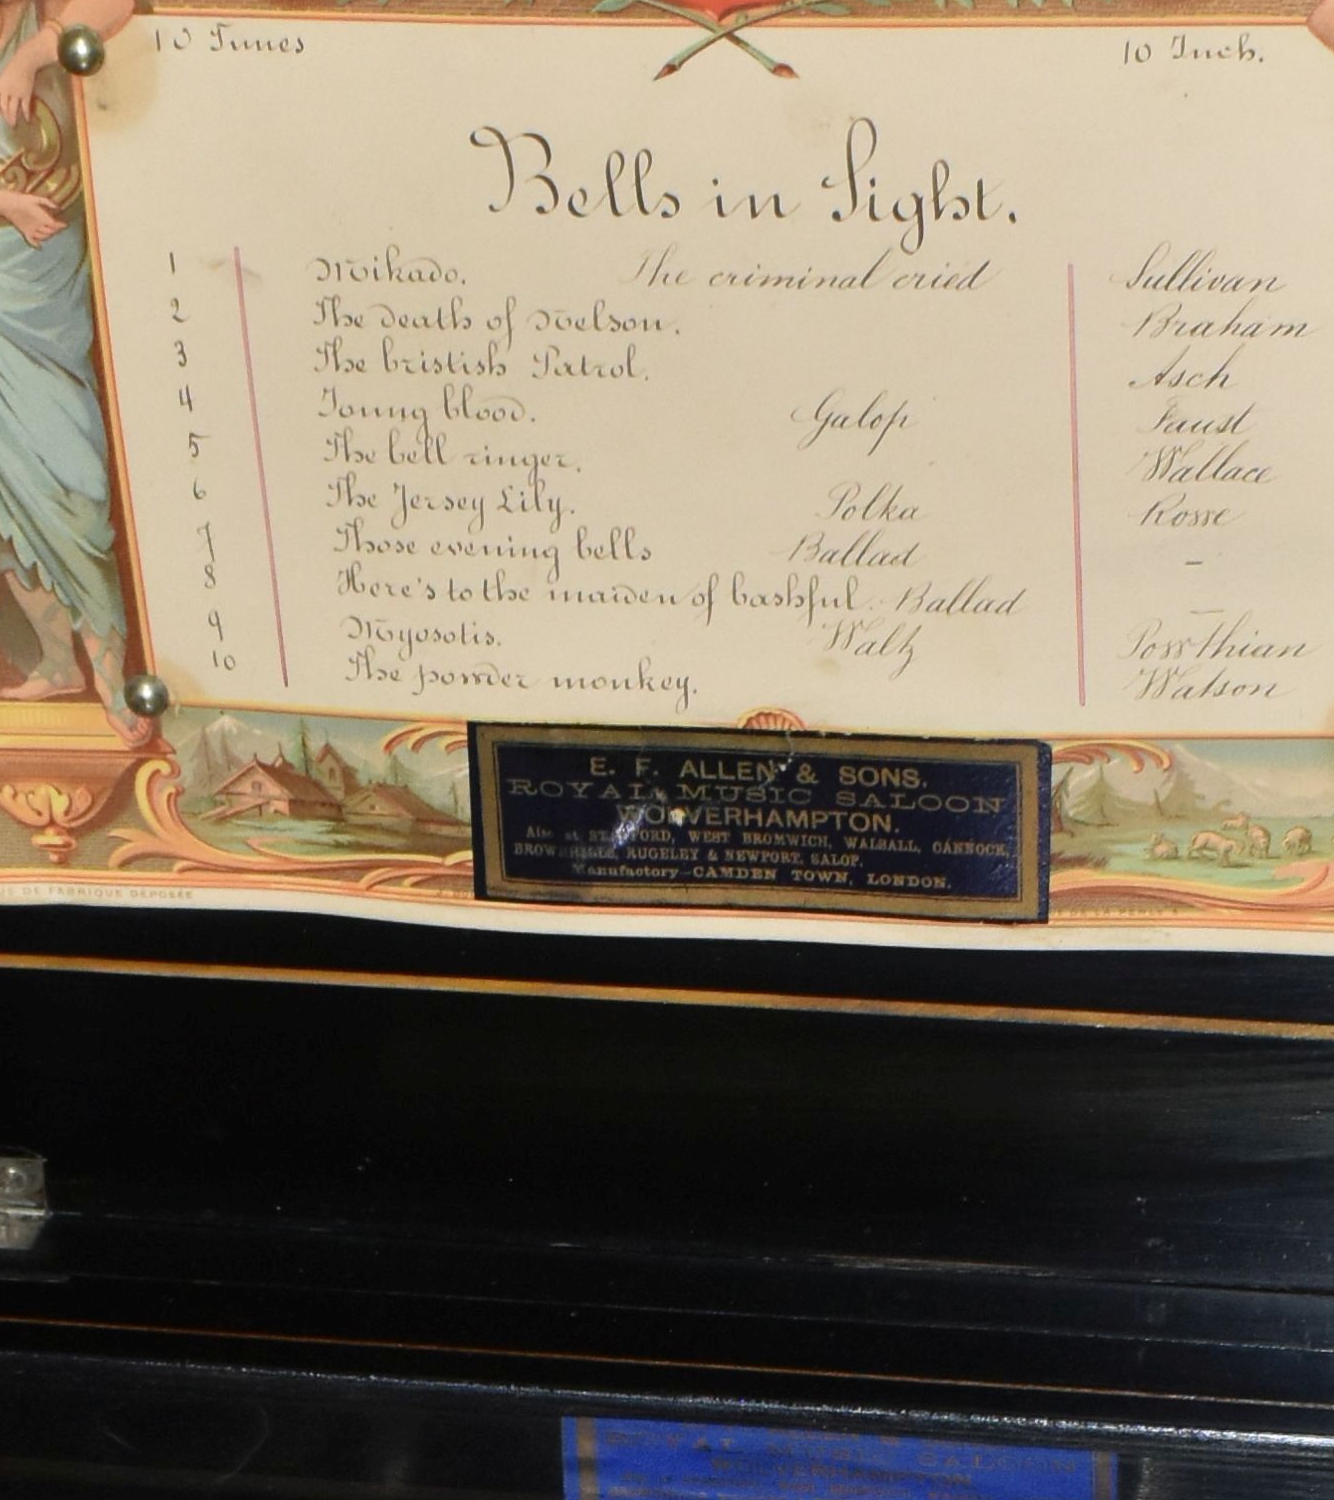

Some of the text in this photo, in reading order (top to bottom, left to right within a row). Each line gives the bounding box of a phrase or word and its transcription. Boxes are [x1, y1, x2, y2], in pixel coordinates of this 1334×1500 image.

[154, 23, 306, 53] 10 Tunes
[1124, 33, 1264, 64] 10 Inch.
[469, 117, 1017, 254] Bells in Sight.
[169, 241, 1287, 293] 1 Mikado. The criminal cried Sullivan
[172, 295, 1322, 351] 2 The death of Nelson. Braham
[174, 341, 188, 367] 3
[314, 336, 365, 373] The
[532, 344, 649, 381] Patrol.
[1128, 344, 1239, 390] Asch
[178, 384, 1259, 456] 4 Young blood. Galop Faust
[188, 431, 1280, 488] 5 The bell ringer. Wallace
[192, 476, 1246, 533] 6 The Jersey Lily. Polka Rosse
[196, 521, 921, 583] 7 Those evening bells Ballad
[204, 564, 217, 589] 8
[337, 561, 437, 599] Here's
[448, 578, 473, 602] to
[482, 571, 530, 602] the
[547, 583, 691, 607] maiden
[691, 571, 719, 627] of
[892, 575, 1031, 616] Ballad
[207, 610, 224, 641] 9
[341, 615, 502, 660] Myosotis.
[821, 618, 923, 680] Waltz
[212, 646, 1299, 713] 10 The powder monkey. Watson
[506, 778, 1007, 814] ROYAL MUSIC SALOON
[589, 756, 929, 789] E. F. ALLEN & SONS.
[588, 828, 676, 846] STFORD,
[688, 829, 732, 844] WEST
[742, 832, 833, 850] BROMWICH,
[845, 835, 922, 853] WALSALL,
[616, 803, 900, 834] WOVERHAMPTON.
[626, 846, 701, 863] RUGELEY
[707, 849, 719, 862] &
[810, 853, 864, 869] SALOP.
[693, 866, 778, 882] CAMDEN
[790, 868, 854, 886] TOWN,
[867, 871, 953, 890] LONDON.
[23, 886, 43, 898] DE
[48, 886, 123, 899] FABRIQUE
